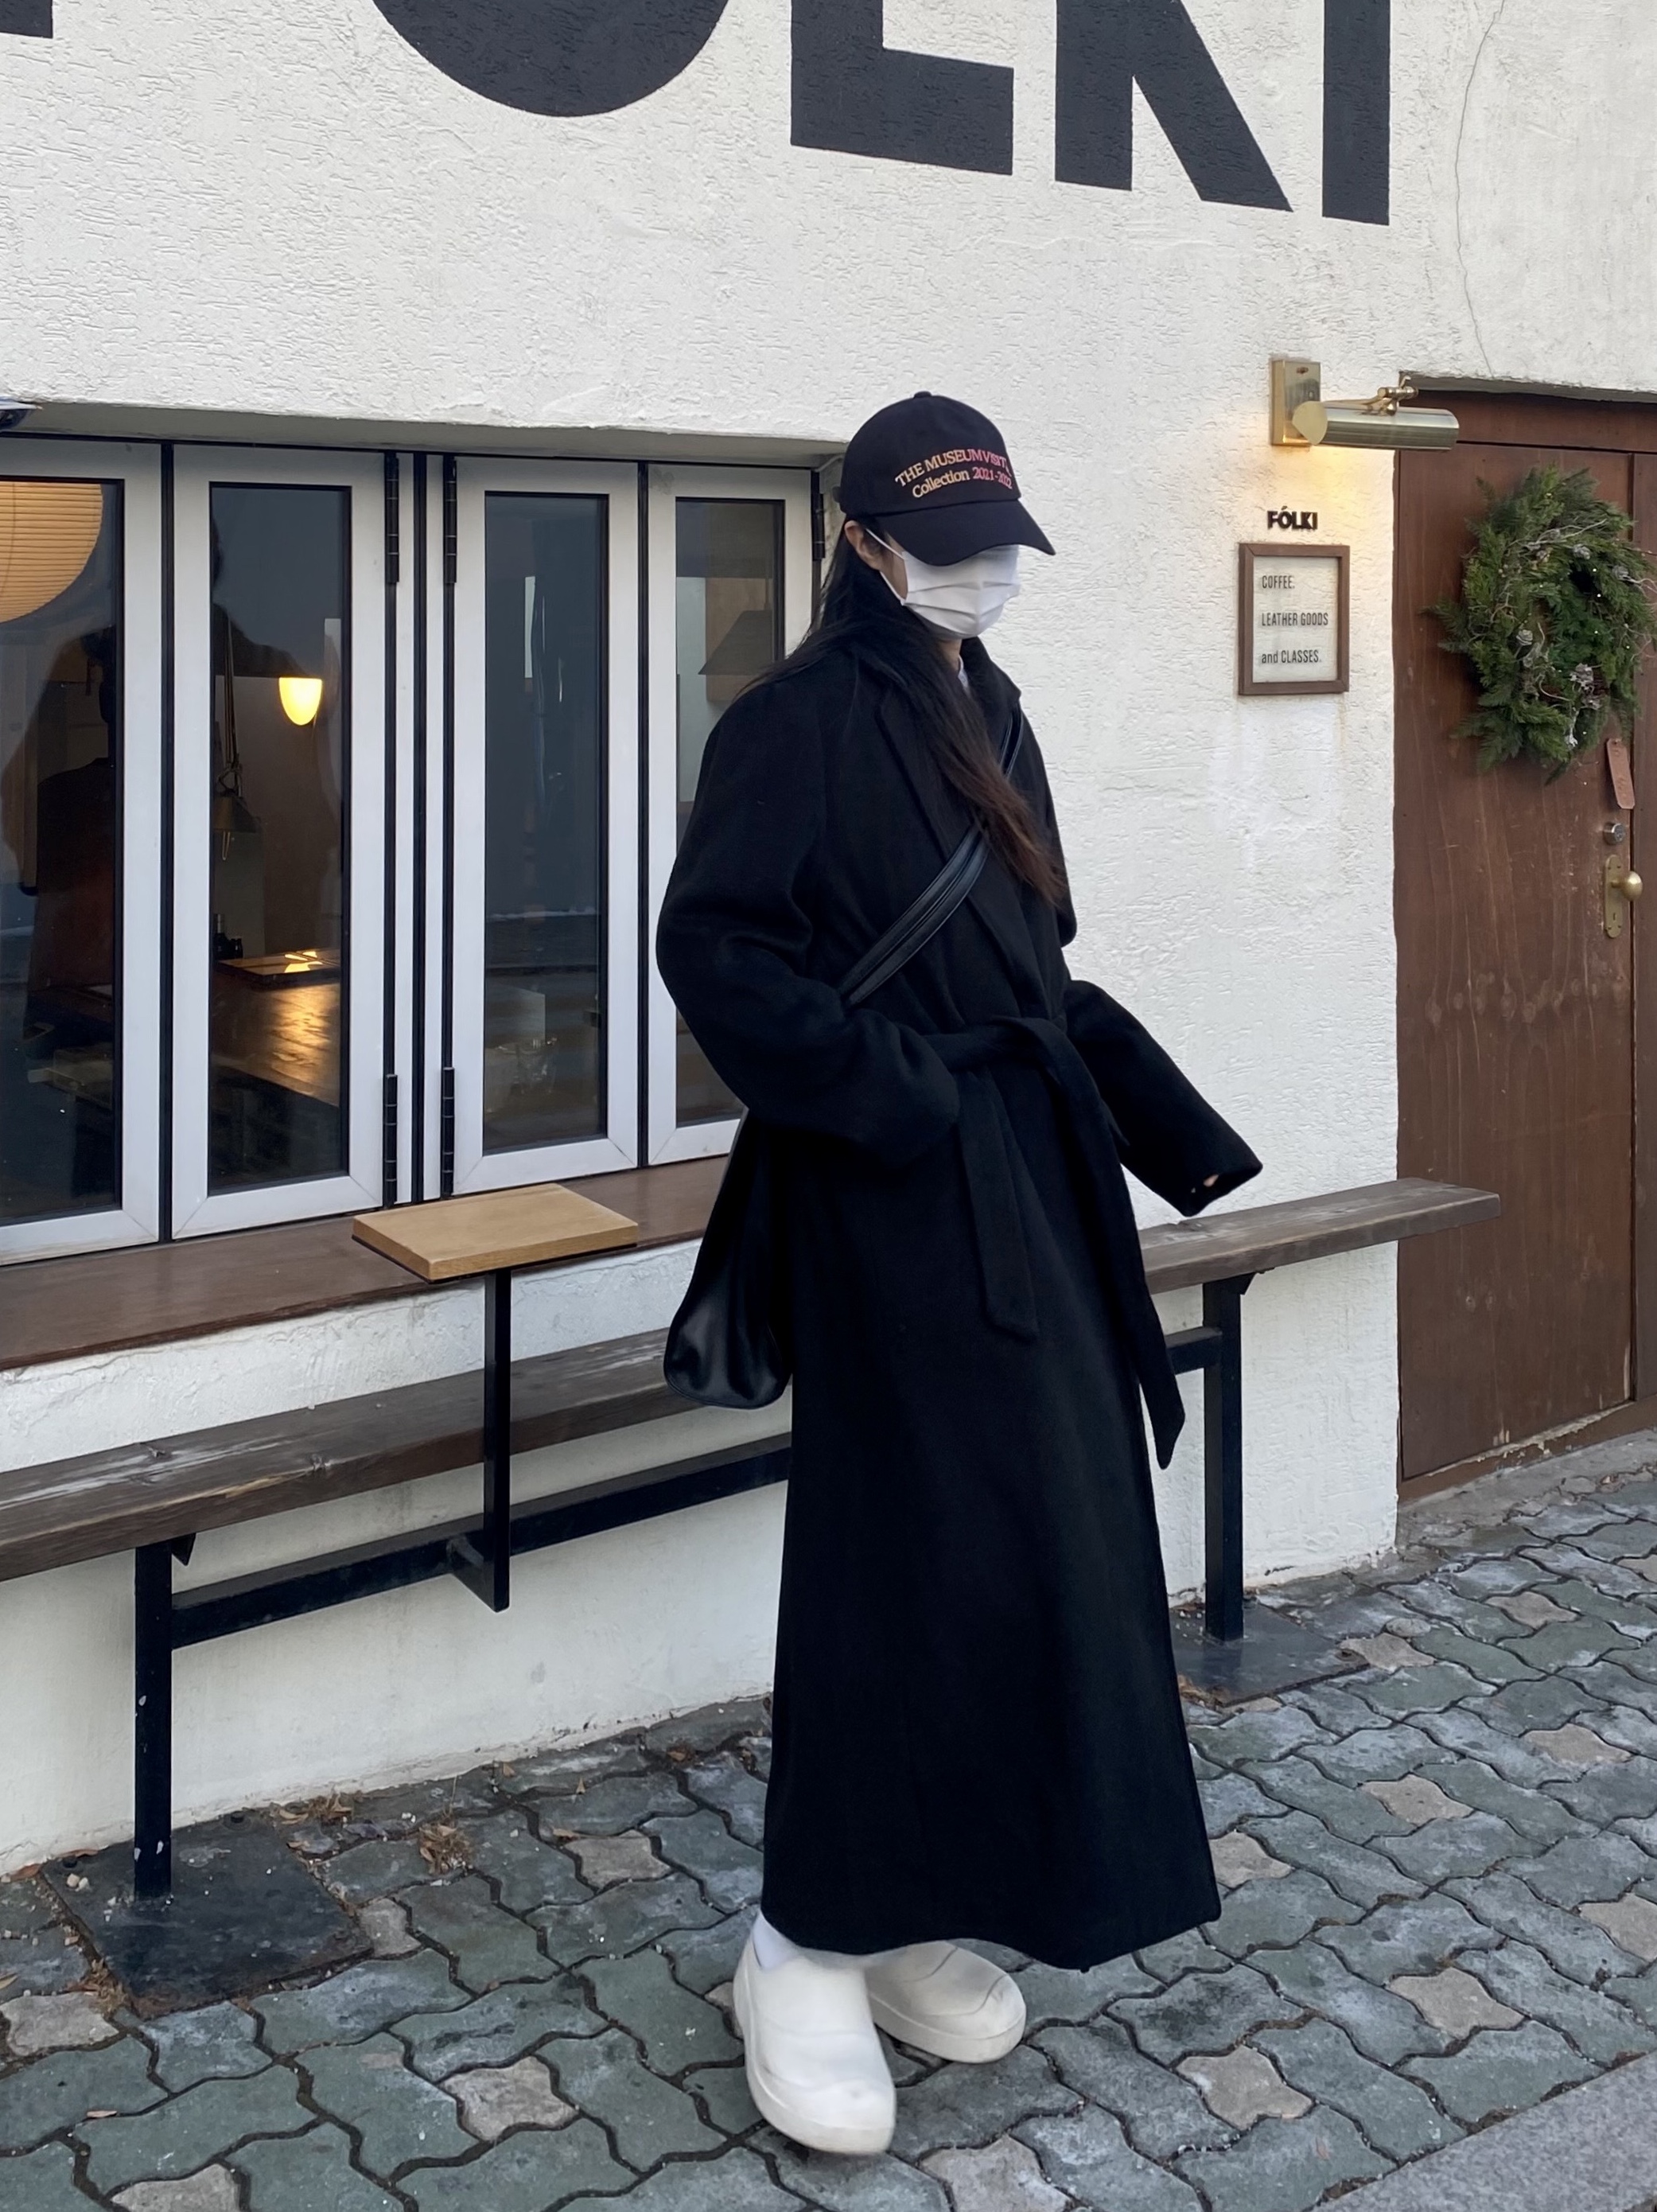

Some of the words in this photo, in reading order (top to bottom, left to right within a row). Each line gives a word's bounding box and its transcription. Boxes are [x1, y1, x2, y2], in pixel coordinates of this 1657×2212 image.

[895, 462, 925, 487] THE
[912, 469, 970, 498] Collection
[1267, 505, 1318, 531] FÓLKI
[1262, 612, 1298, 626] LEATHER
[1301, 612, 1328, 626] GOODS
[1262, 650, 1278, 664] and
